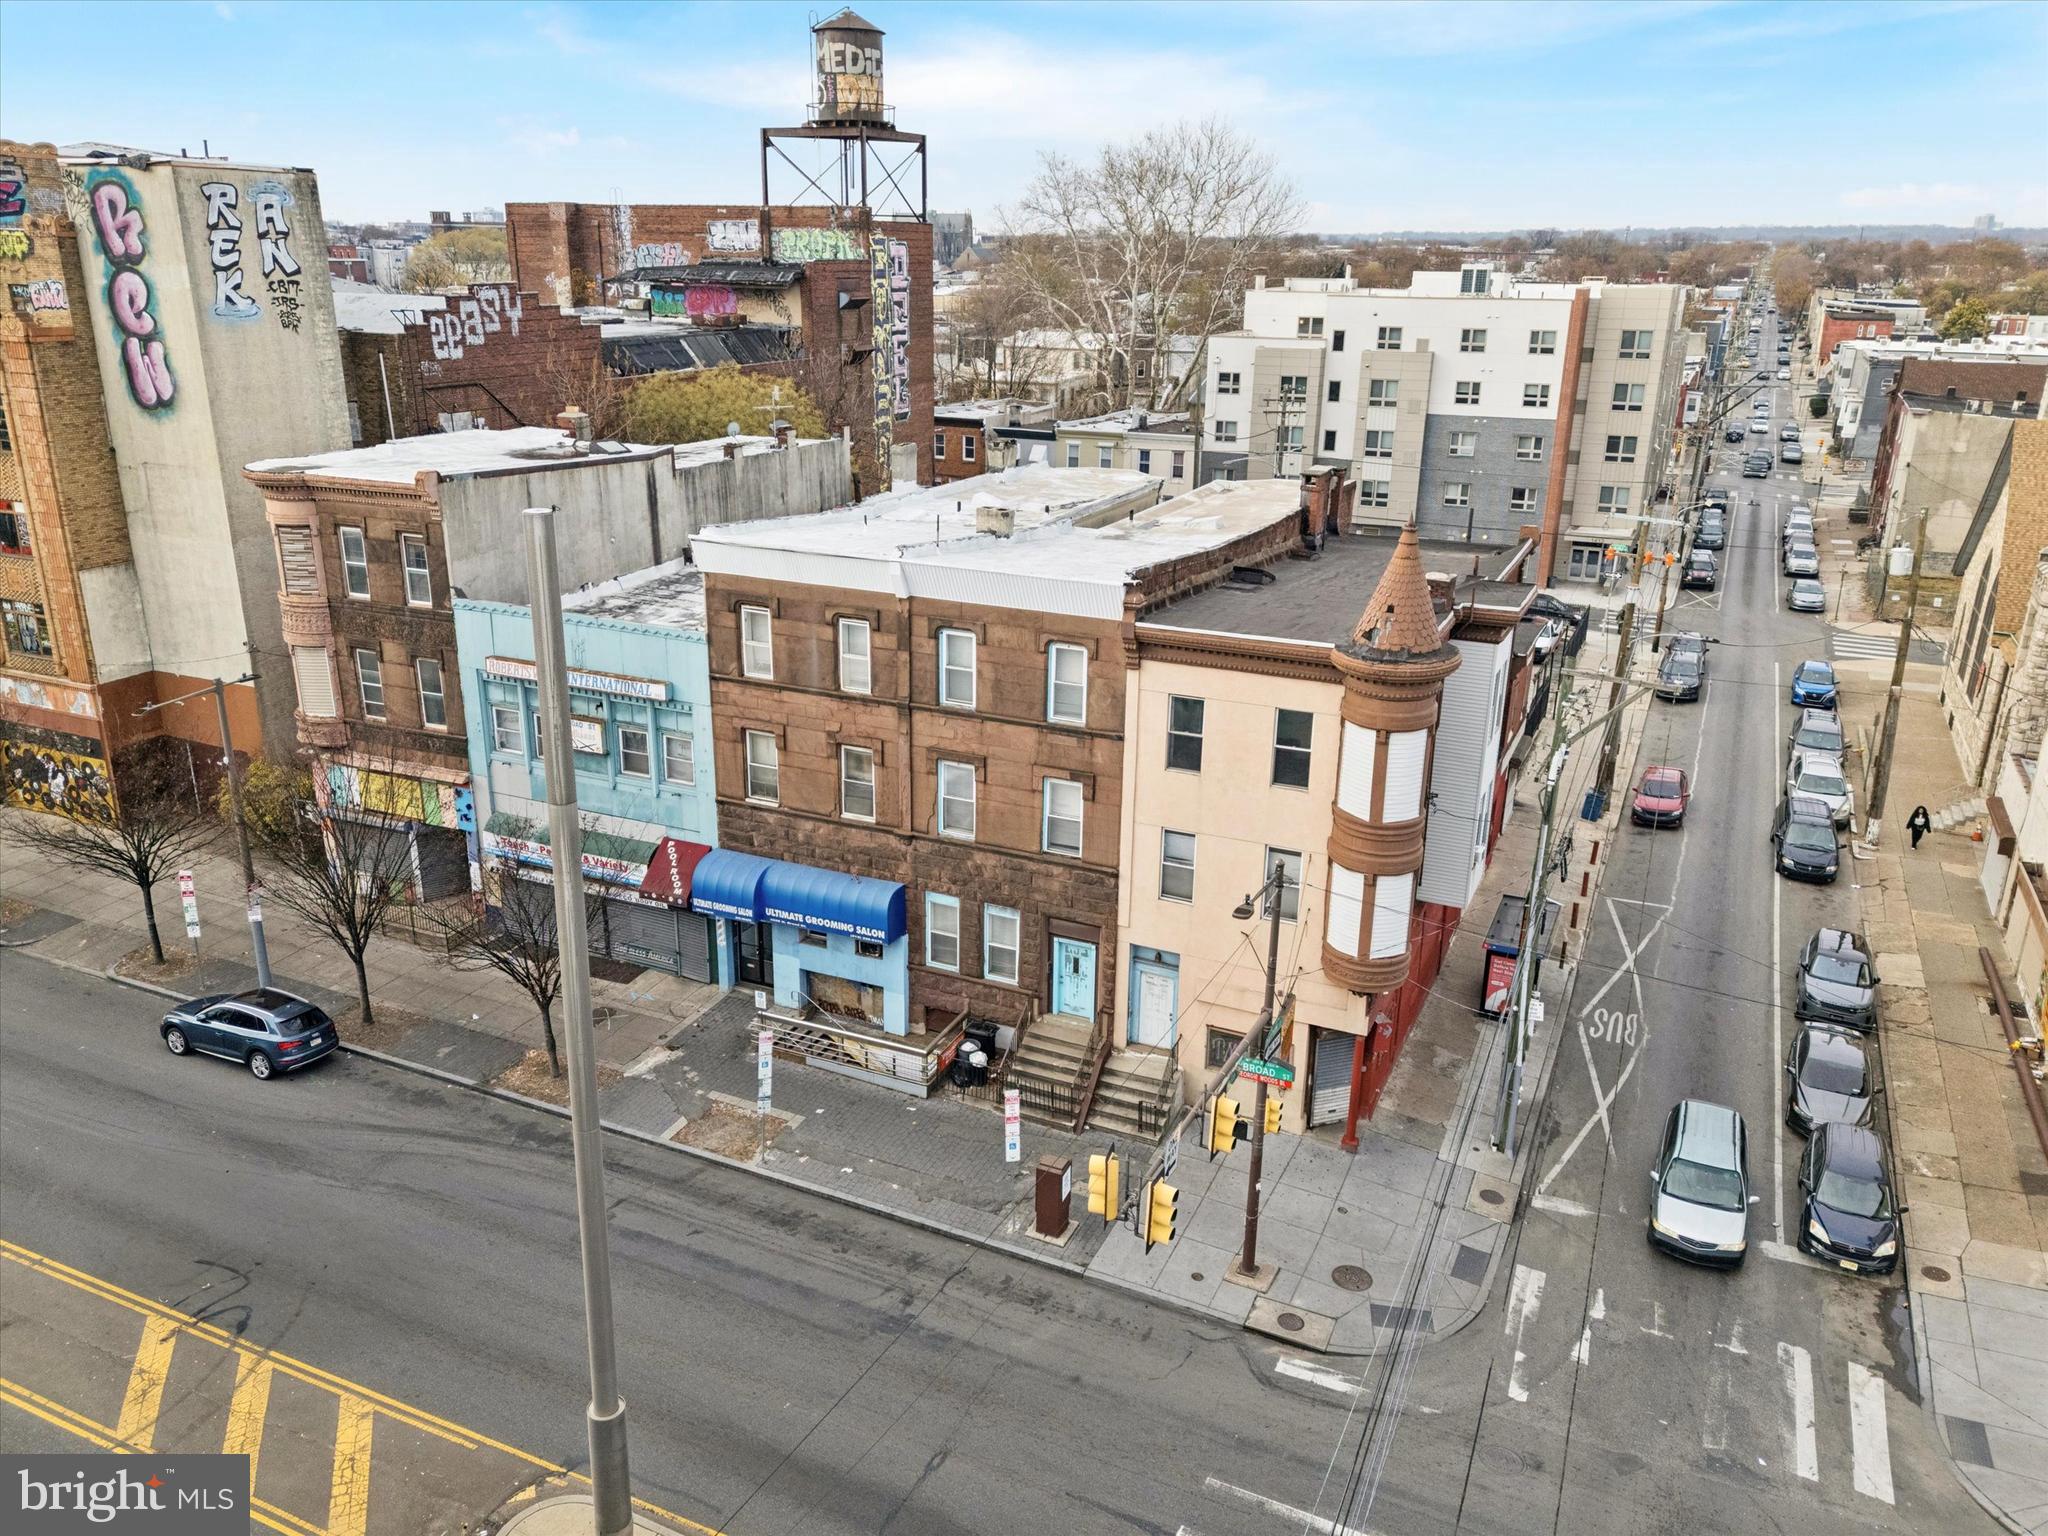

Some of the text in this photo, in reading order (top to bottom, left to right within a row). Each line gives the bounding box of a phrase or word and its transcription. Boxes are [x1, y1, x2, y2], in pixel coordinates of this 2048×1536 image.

[765, 907, 804, 923] ULTIMATE
[805, 915, 854, 932] GROOMING
[856, 925, 886, 940] SALON
[1590, 1008, 1639, 1047] BUS
[1242, 1063, 1276, 1077] BROAD
